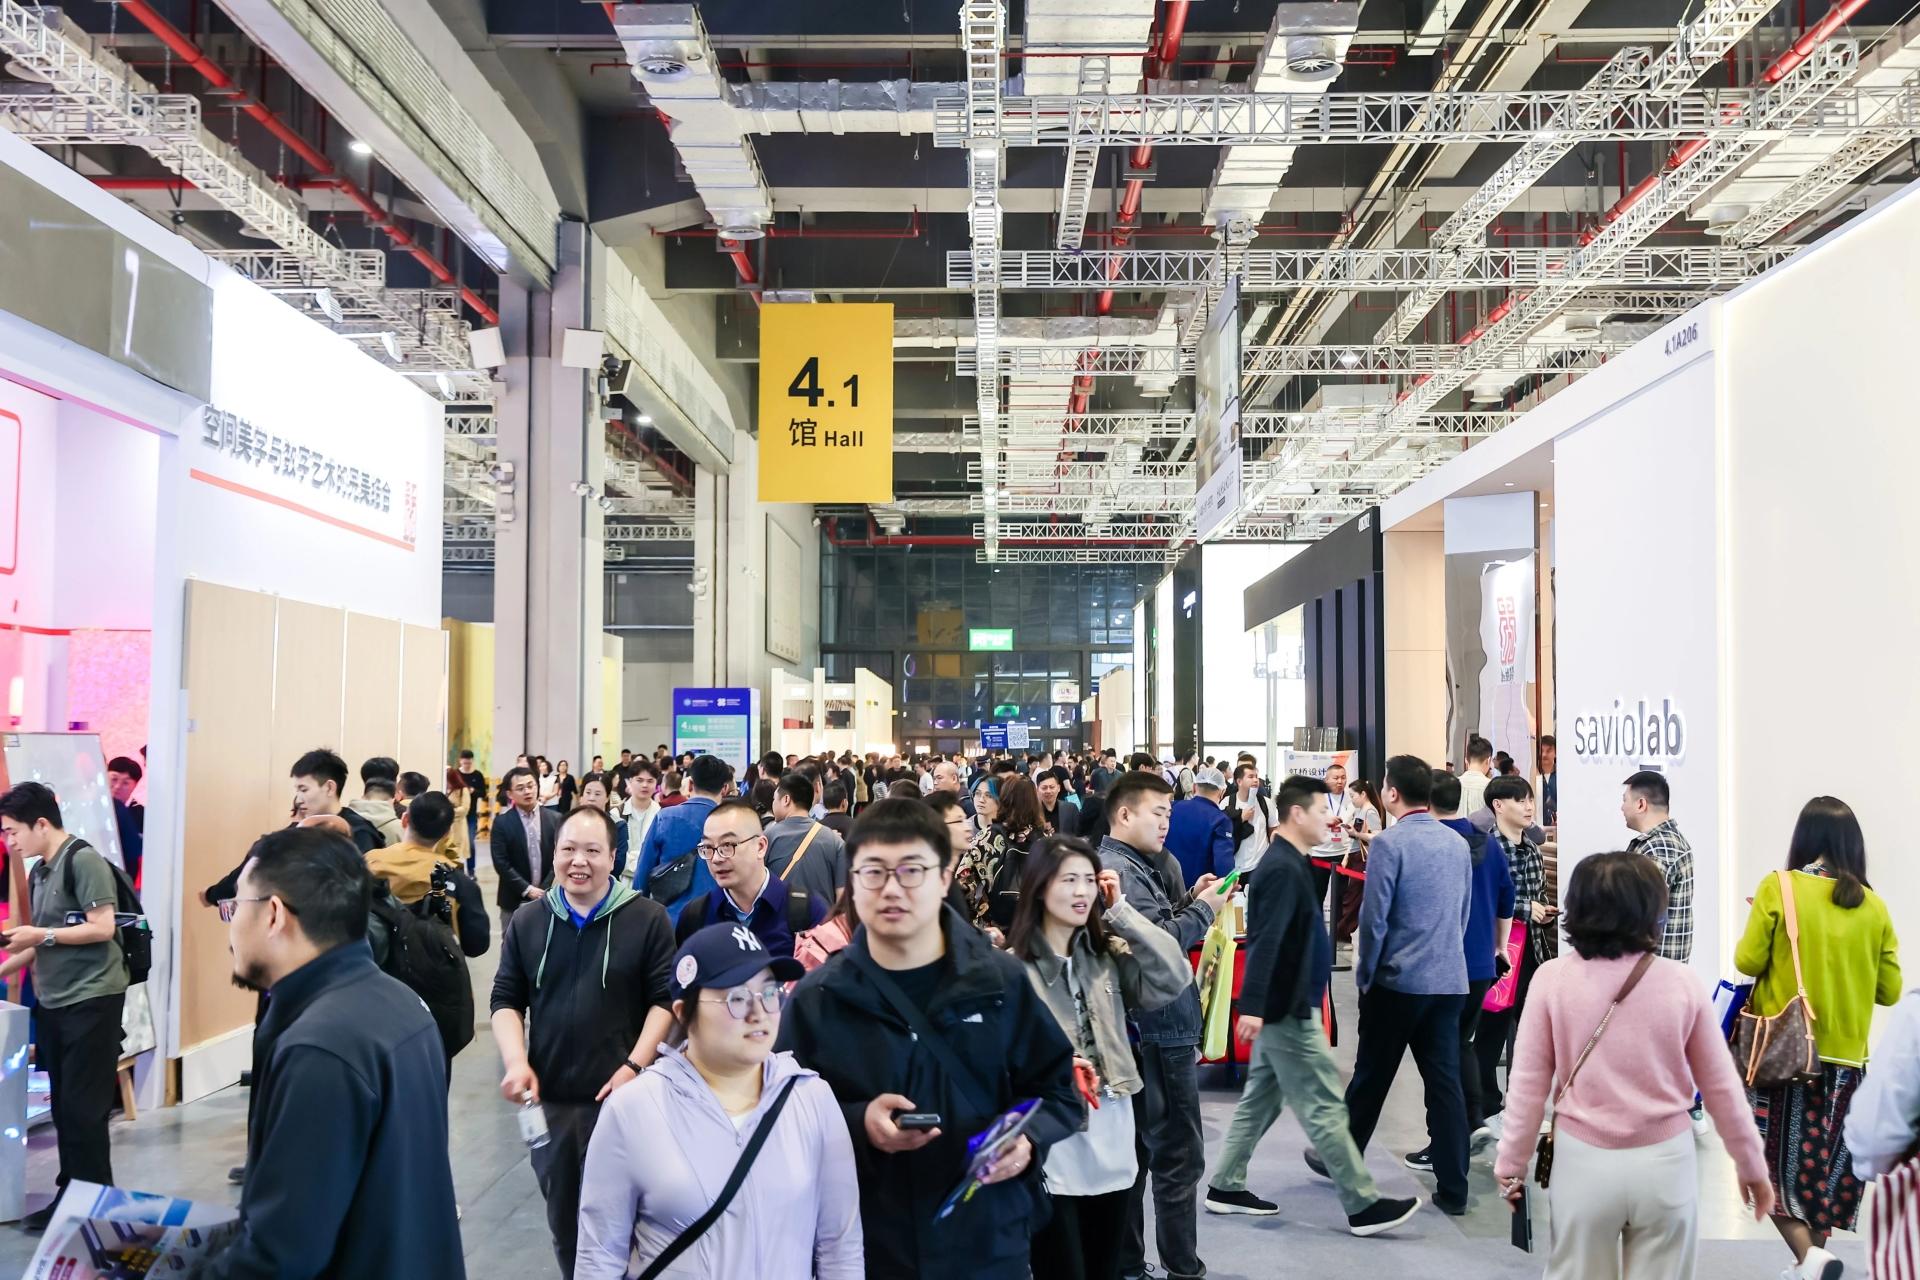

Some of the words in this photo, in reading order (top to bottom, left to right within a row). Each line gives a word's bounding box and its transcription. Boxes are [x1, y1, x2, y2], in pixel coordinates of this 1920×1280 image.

[1665, 322, 1698, 356] 4.1A206
[788, 357, 859, 407] 4.1
[789, 418, 817, 447] 馆
[825, 431, 863, 447] Hall
[1575, 698, 1683, 756] saviolab
